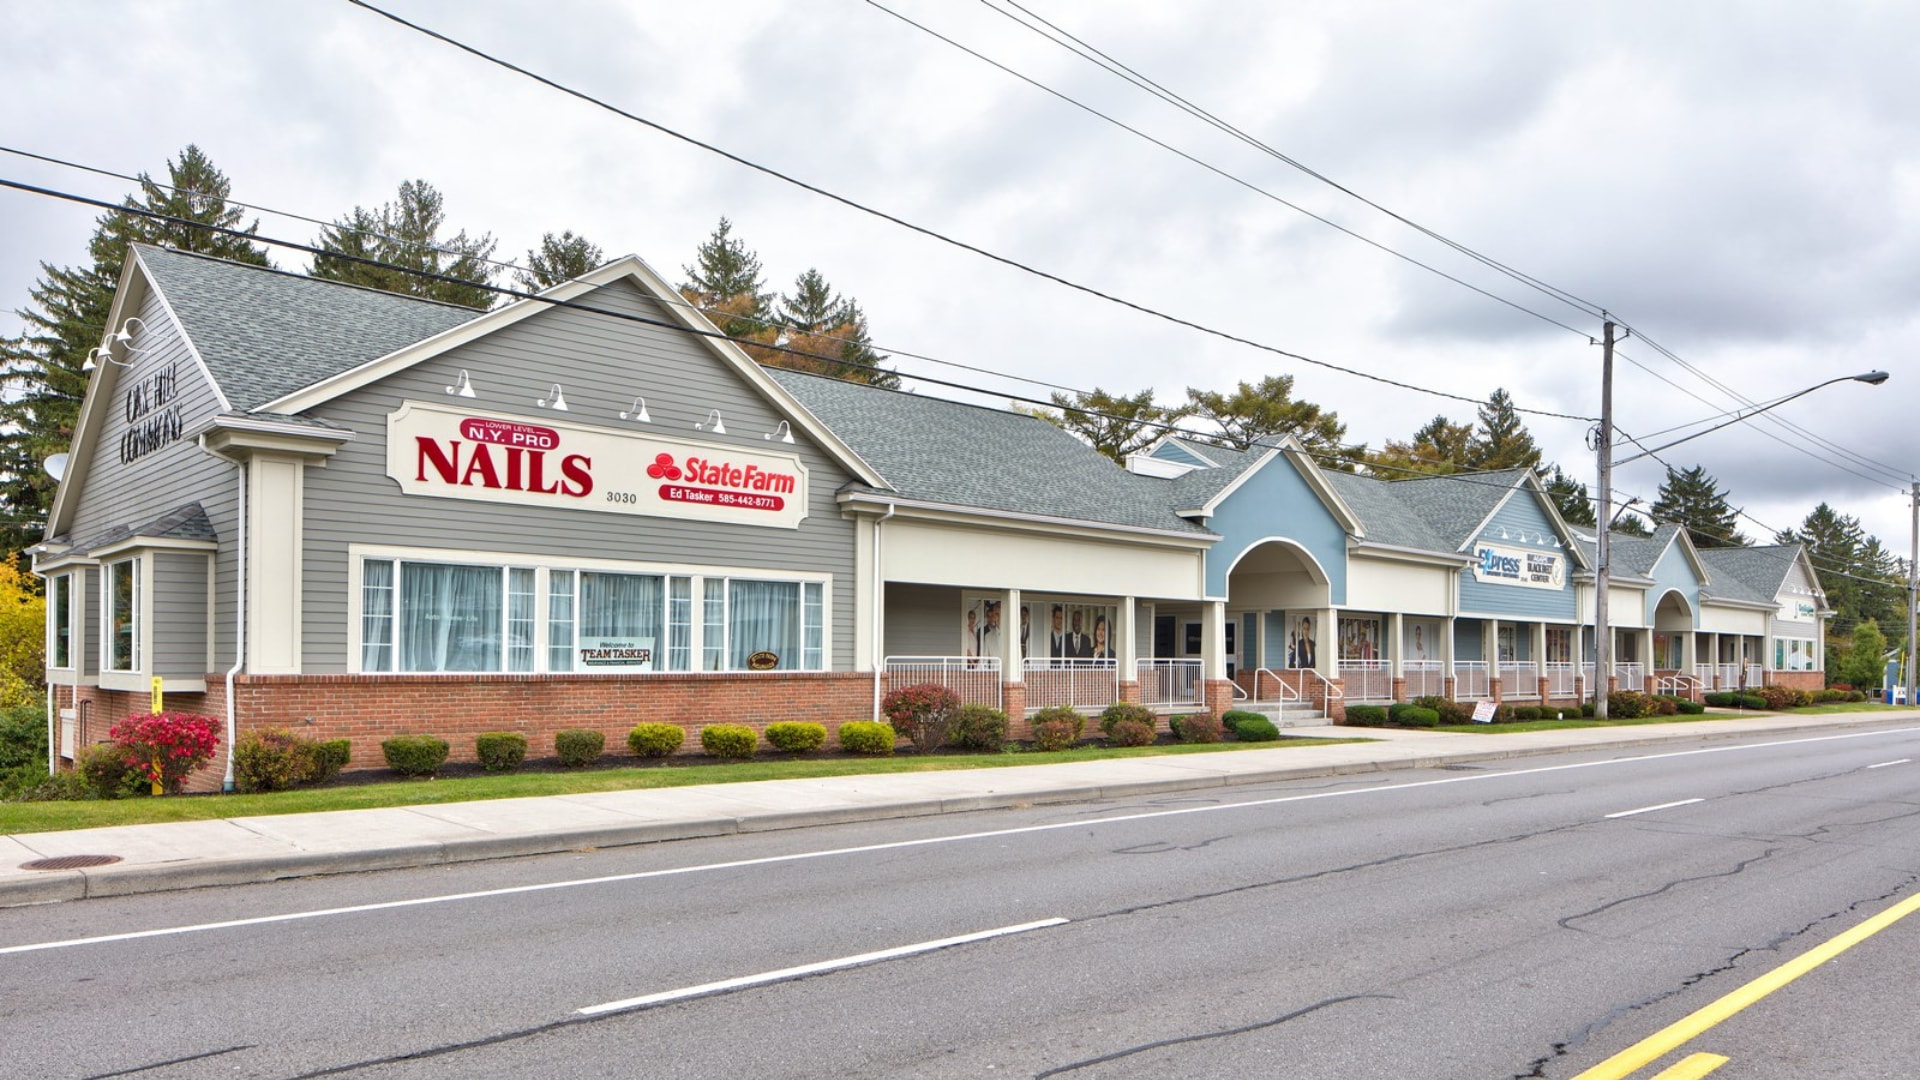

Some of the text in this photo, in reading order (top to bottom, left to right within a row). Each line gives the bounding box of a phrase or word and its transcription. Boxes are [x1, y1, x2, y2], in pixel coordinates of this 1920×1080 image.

[126, 361, 179, 424] OAK HILL
[120, 403, 182, 465] COMMONS
[469, 427, 552, 448] N.Y. PRO
[485, 422, 536, 434] LOWER LEVEL
[415, 436, 594, 498] NAILS
[606, 491, 637, 505] 3030
[670, 487, 775, 508] Ed Tasker 585-442-8771
[1531, 574, 1549, 583] CENTER
[581, 649, 650, 662] TEAM TASKER
